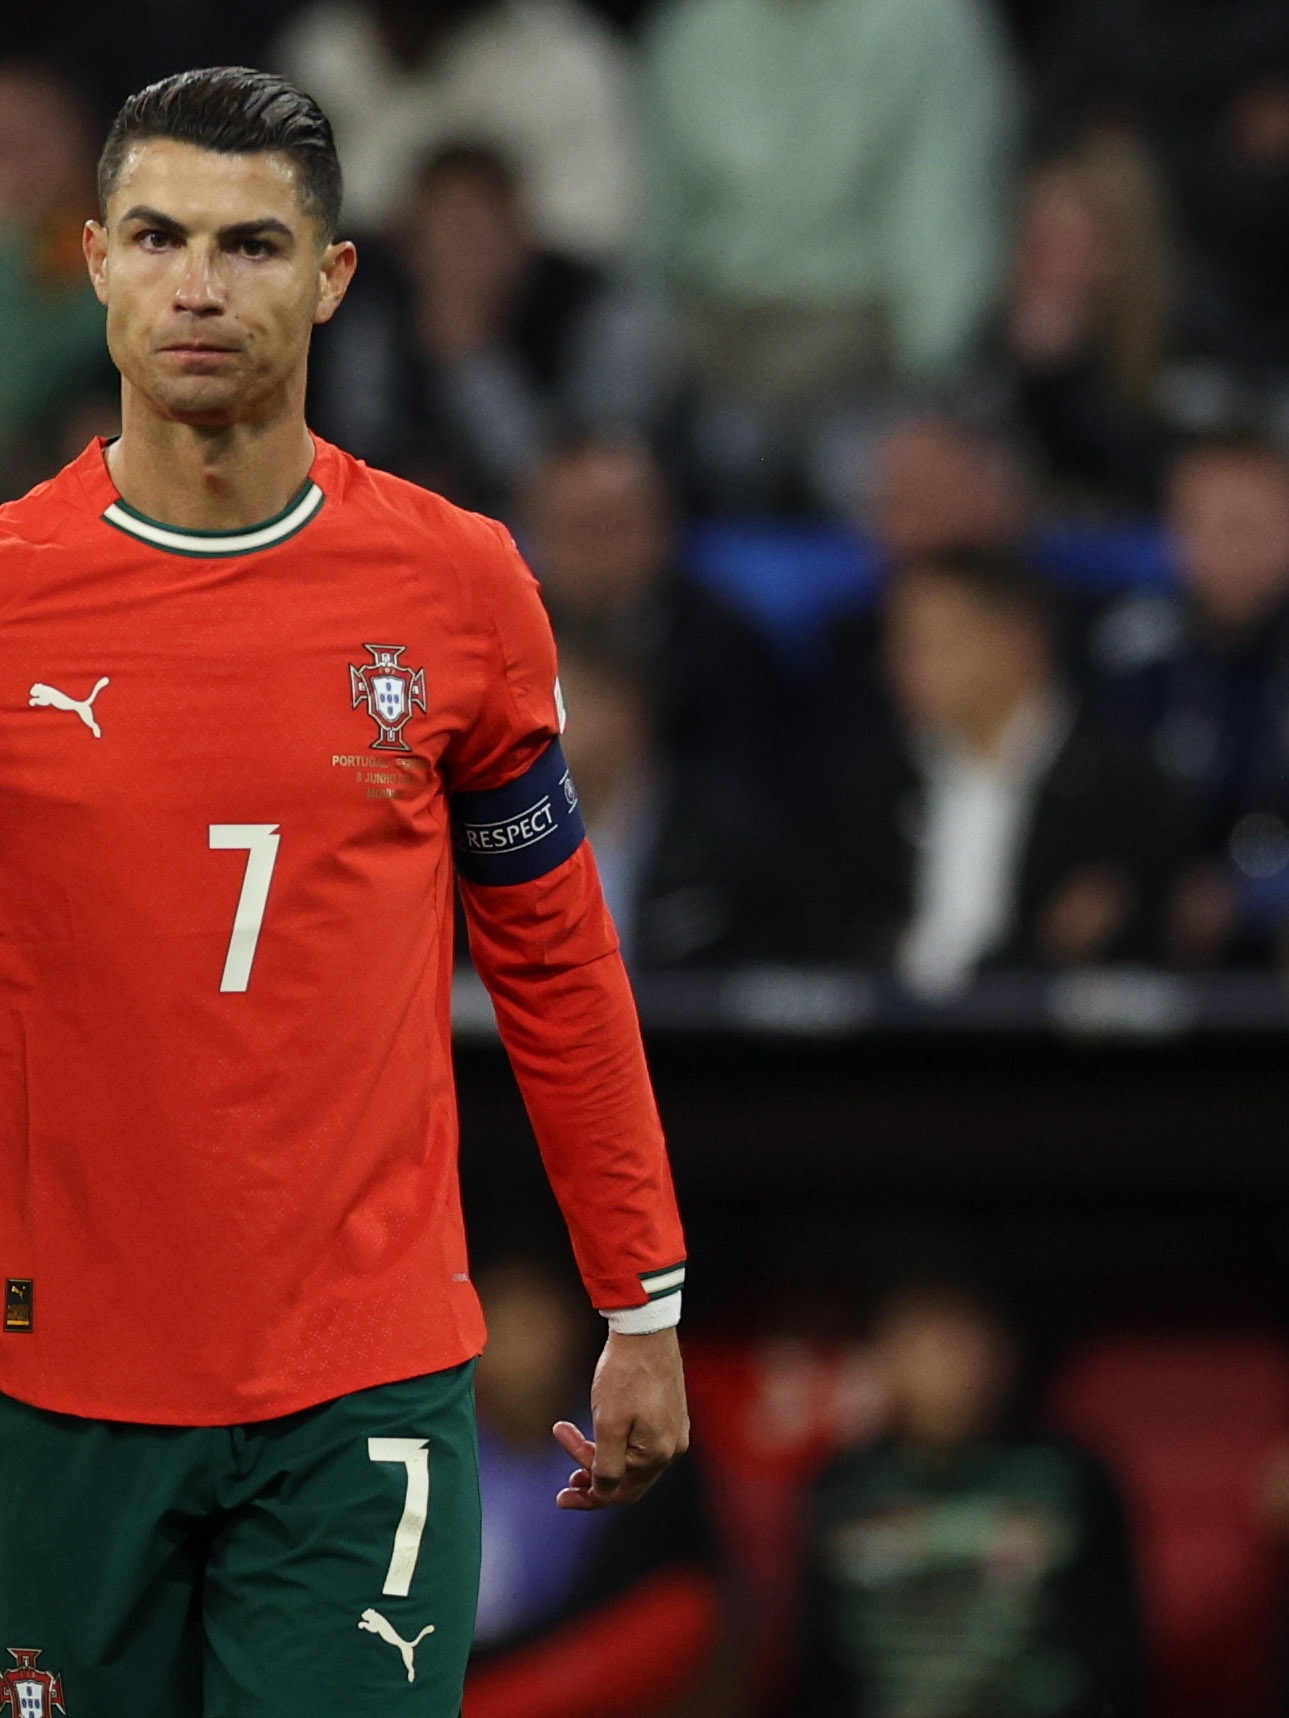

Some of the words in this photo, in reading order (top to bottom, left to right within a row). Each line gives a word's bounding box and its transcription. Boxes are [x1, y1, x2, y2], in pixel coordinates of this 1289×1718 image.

[466, 803, 553, 849] RESPECT
[209, 824, 281, 992] 7
[367, 1437, 431, 1597] 7
